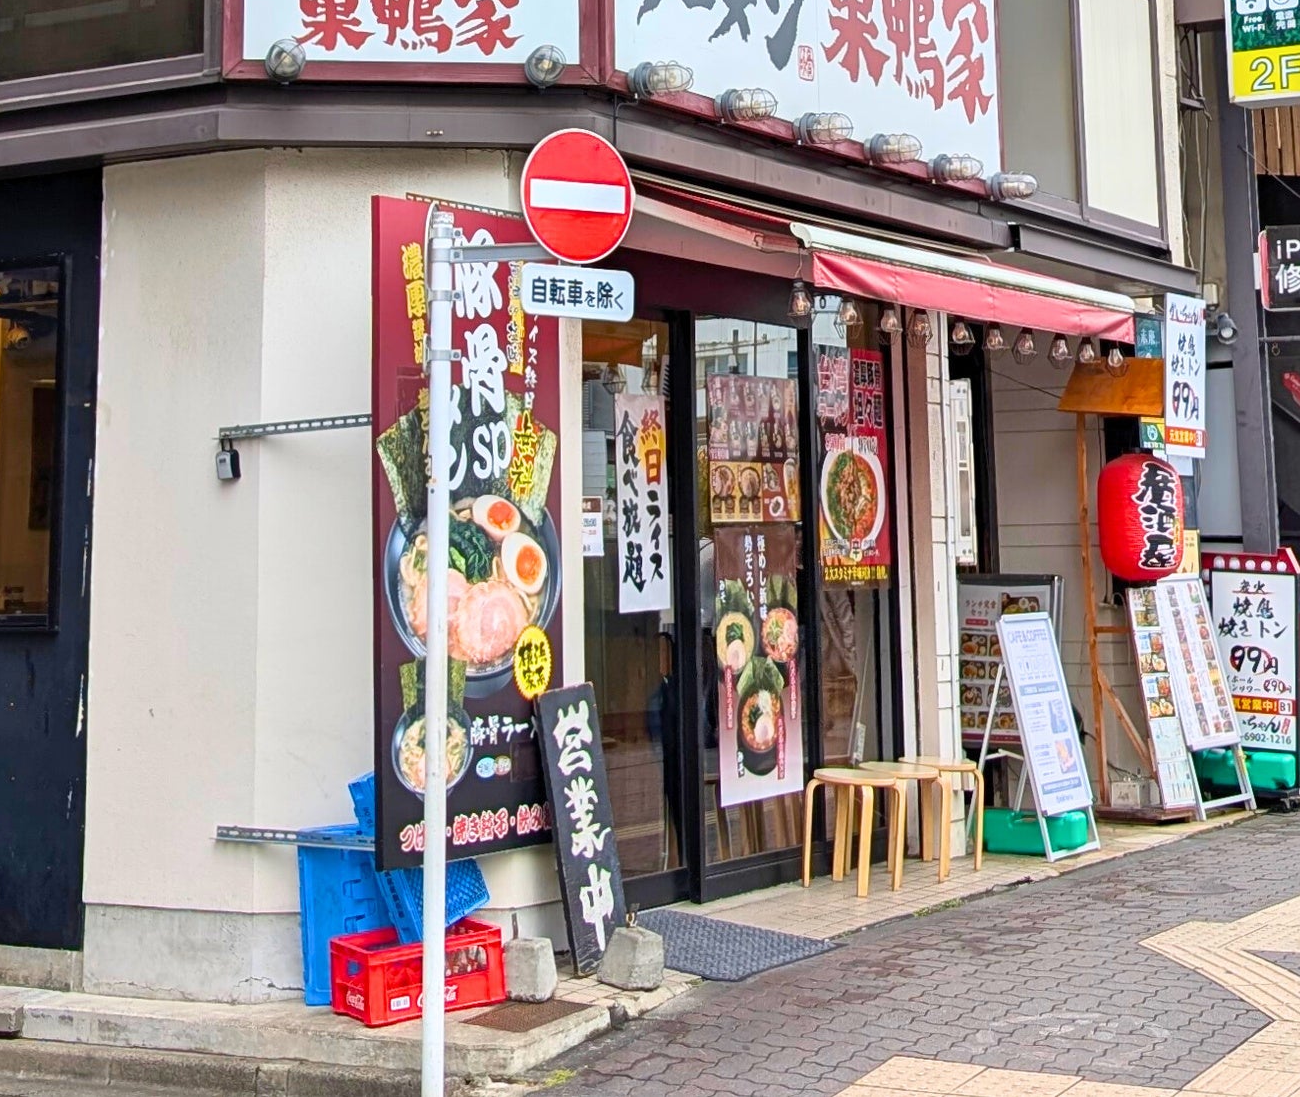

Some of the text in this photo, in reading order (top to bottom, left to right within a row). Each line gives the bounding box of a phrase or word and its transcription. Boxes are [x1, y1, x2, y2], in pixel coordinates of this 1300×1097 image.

[1242, 22, 1266, 33] Wi-Fi
[1243, 13, 1263, 24] Free
[531, 275, 625, 311] 自転車を除く
[1178, 332, 1196, 357] 焼鳥
[1172, 380, 1199, 420] 99円
[617, 410, 647, 593] 食べ放題
[640, 408, 664, 583] 終日ライス
[1132, 461, 1180, 570] 居酒屋
[1233, 596, 1275, 619] 焼鳥
[1218, 616, 1289, 639] 焼きトン
[1229, 644, 1280, 676] 99円
[1280, 700, 1292, 711] B1
[1240, 733, 1292, 745] -6902-1216
[552, 699, 615, 952] 営業中
